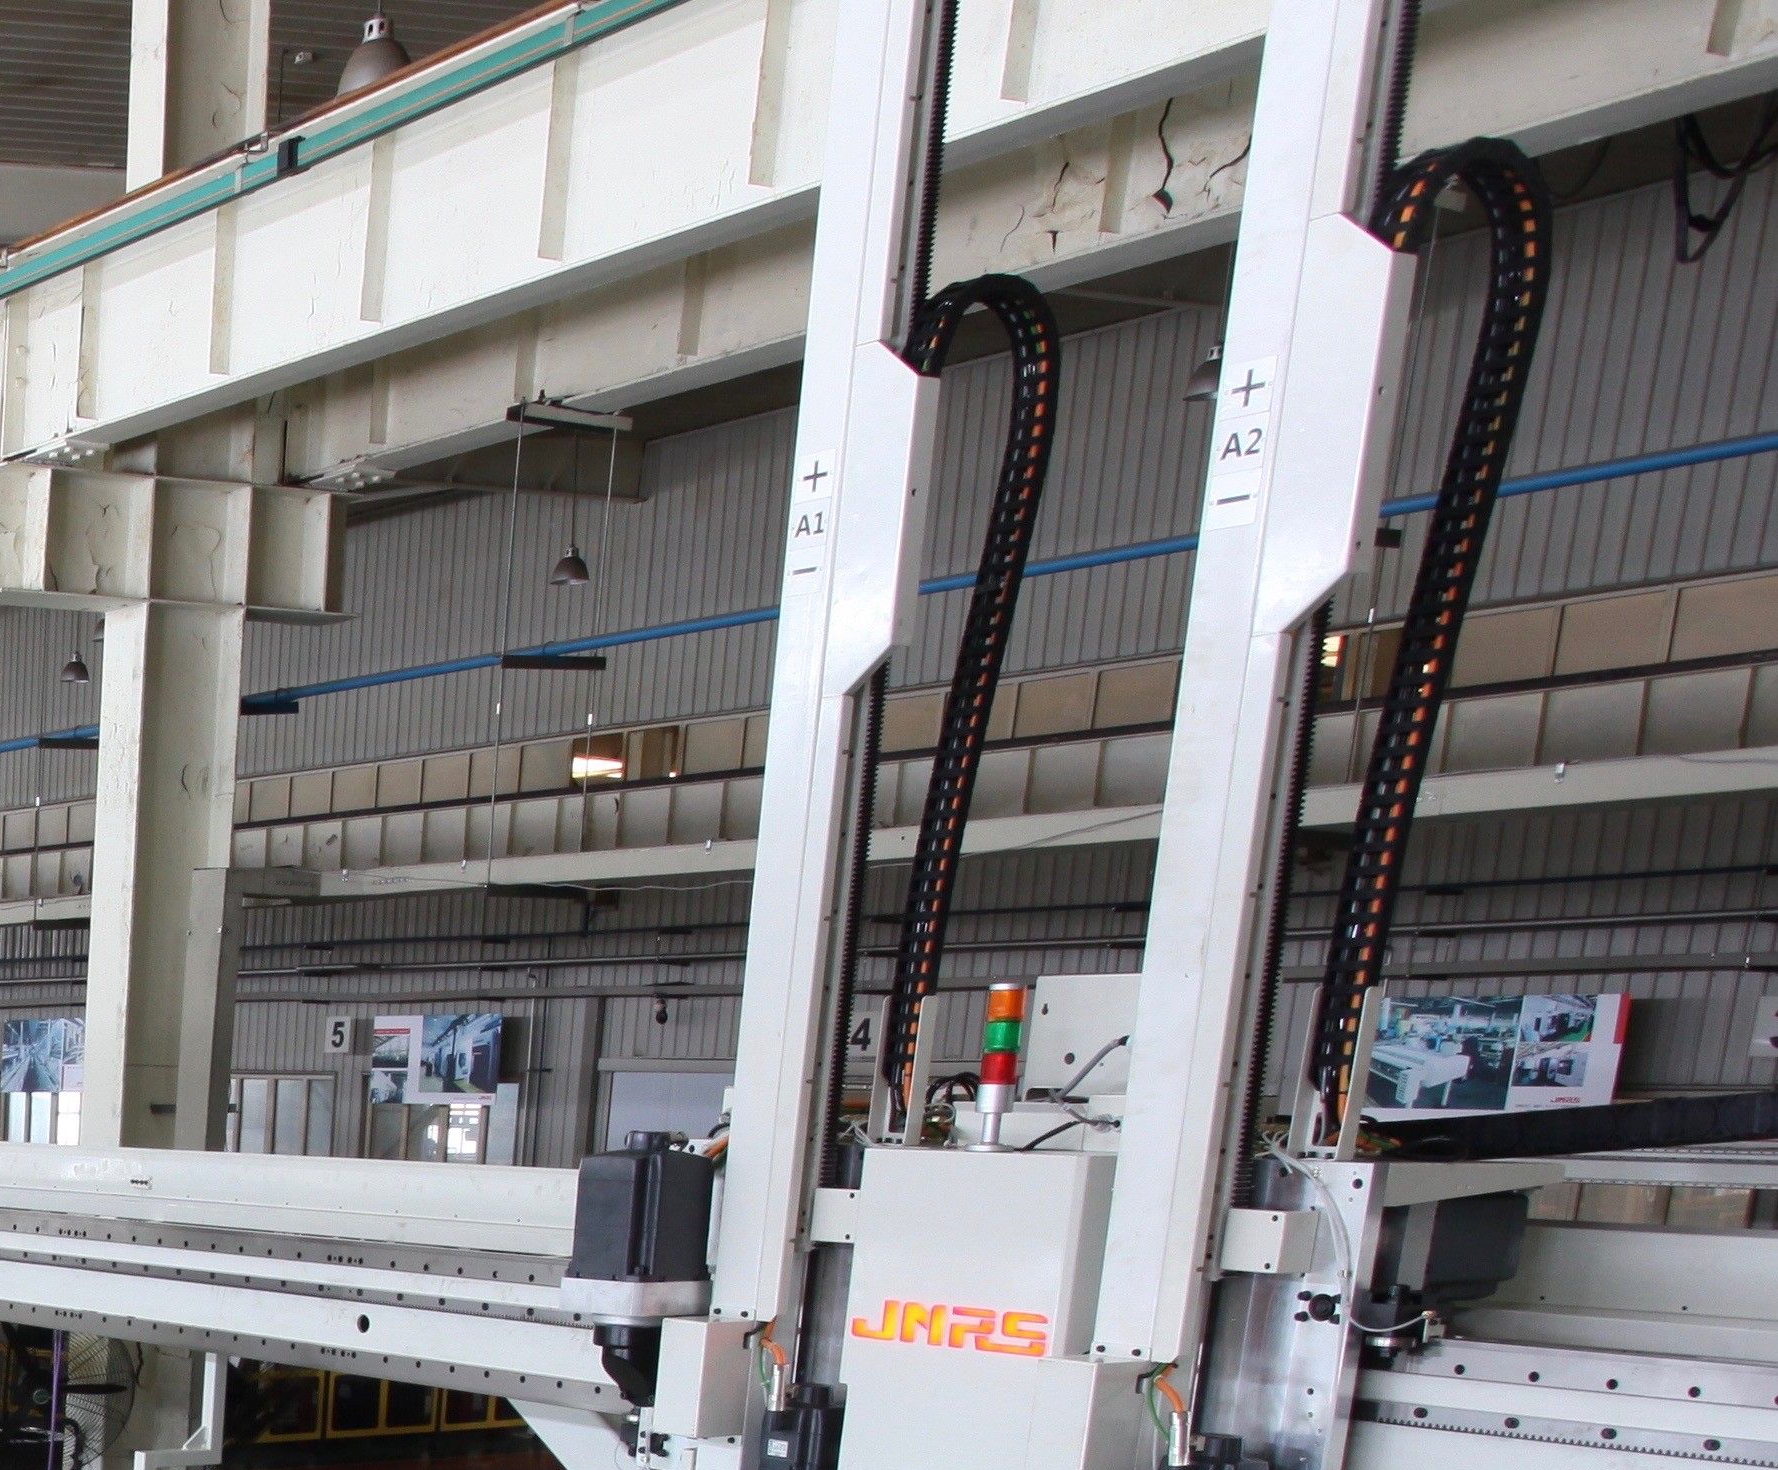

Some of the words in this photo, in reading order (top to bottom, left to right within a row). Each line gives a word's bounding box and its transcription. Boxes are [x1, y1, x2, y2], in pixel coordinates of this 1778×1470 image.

[1220, 428, 1263, 461] A2
[795, 511, 825, 538] A1
[331, 1021, 345, 1047] 5
[851, 1018, 871, 1051] 4
